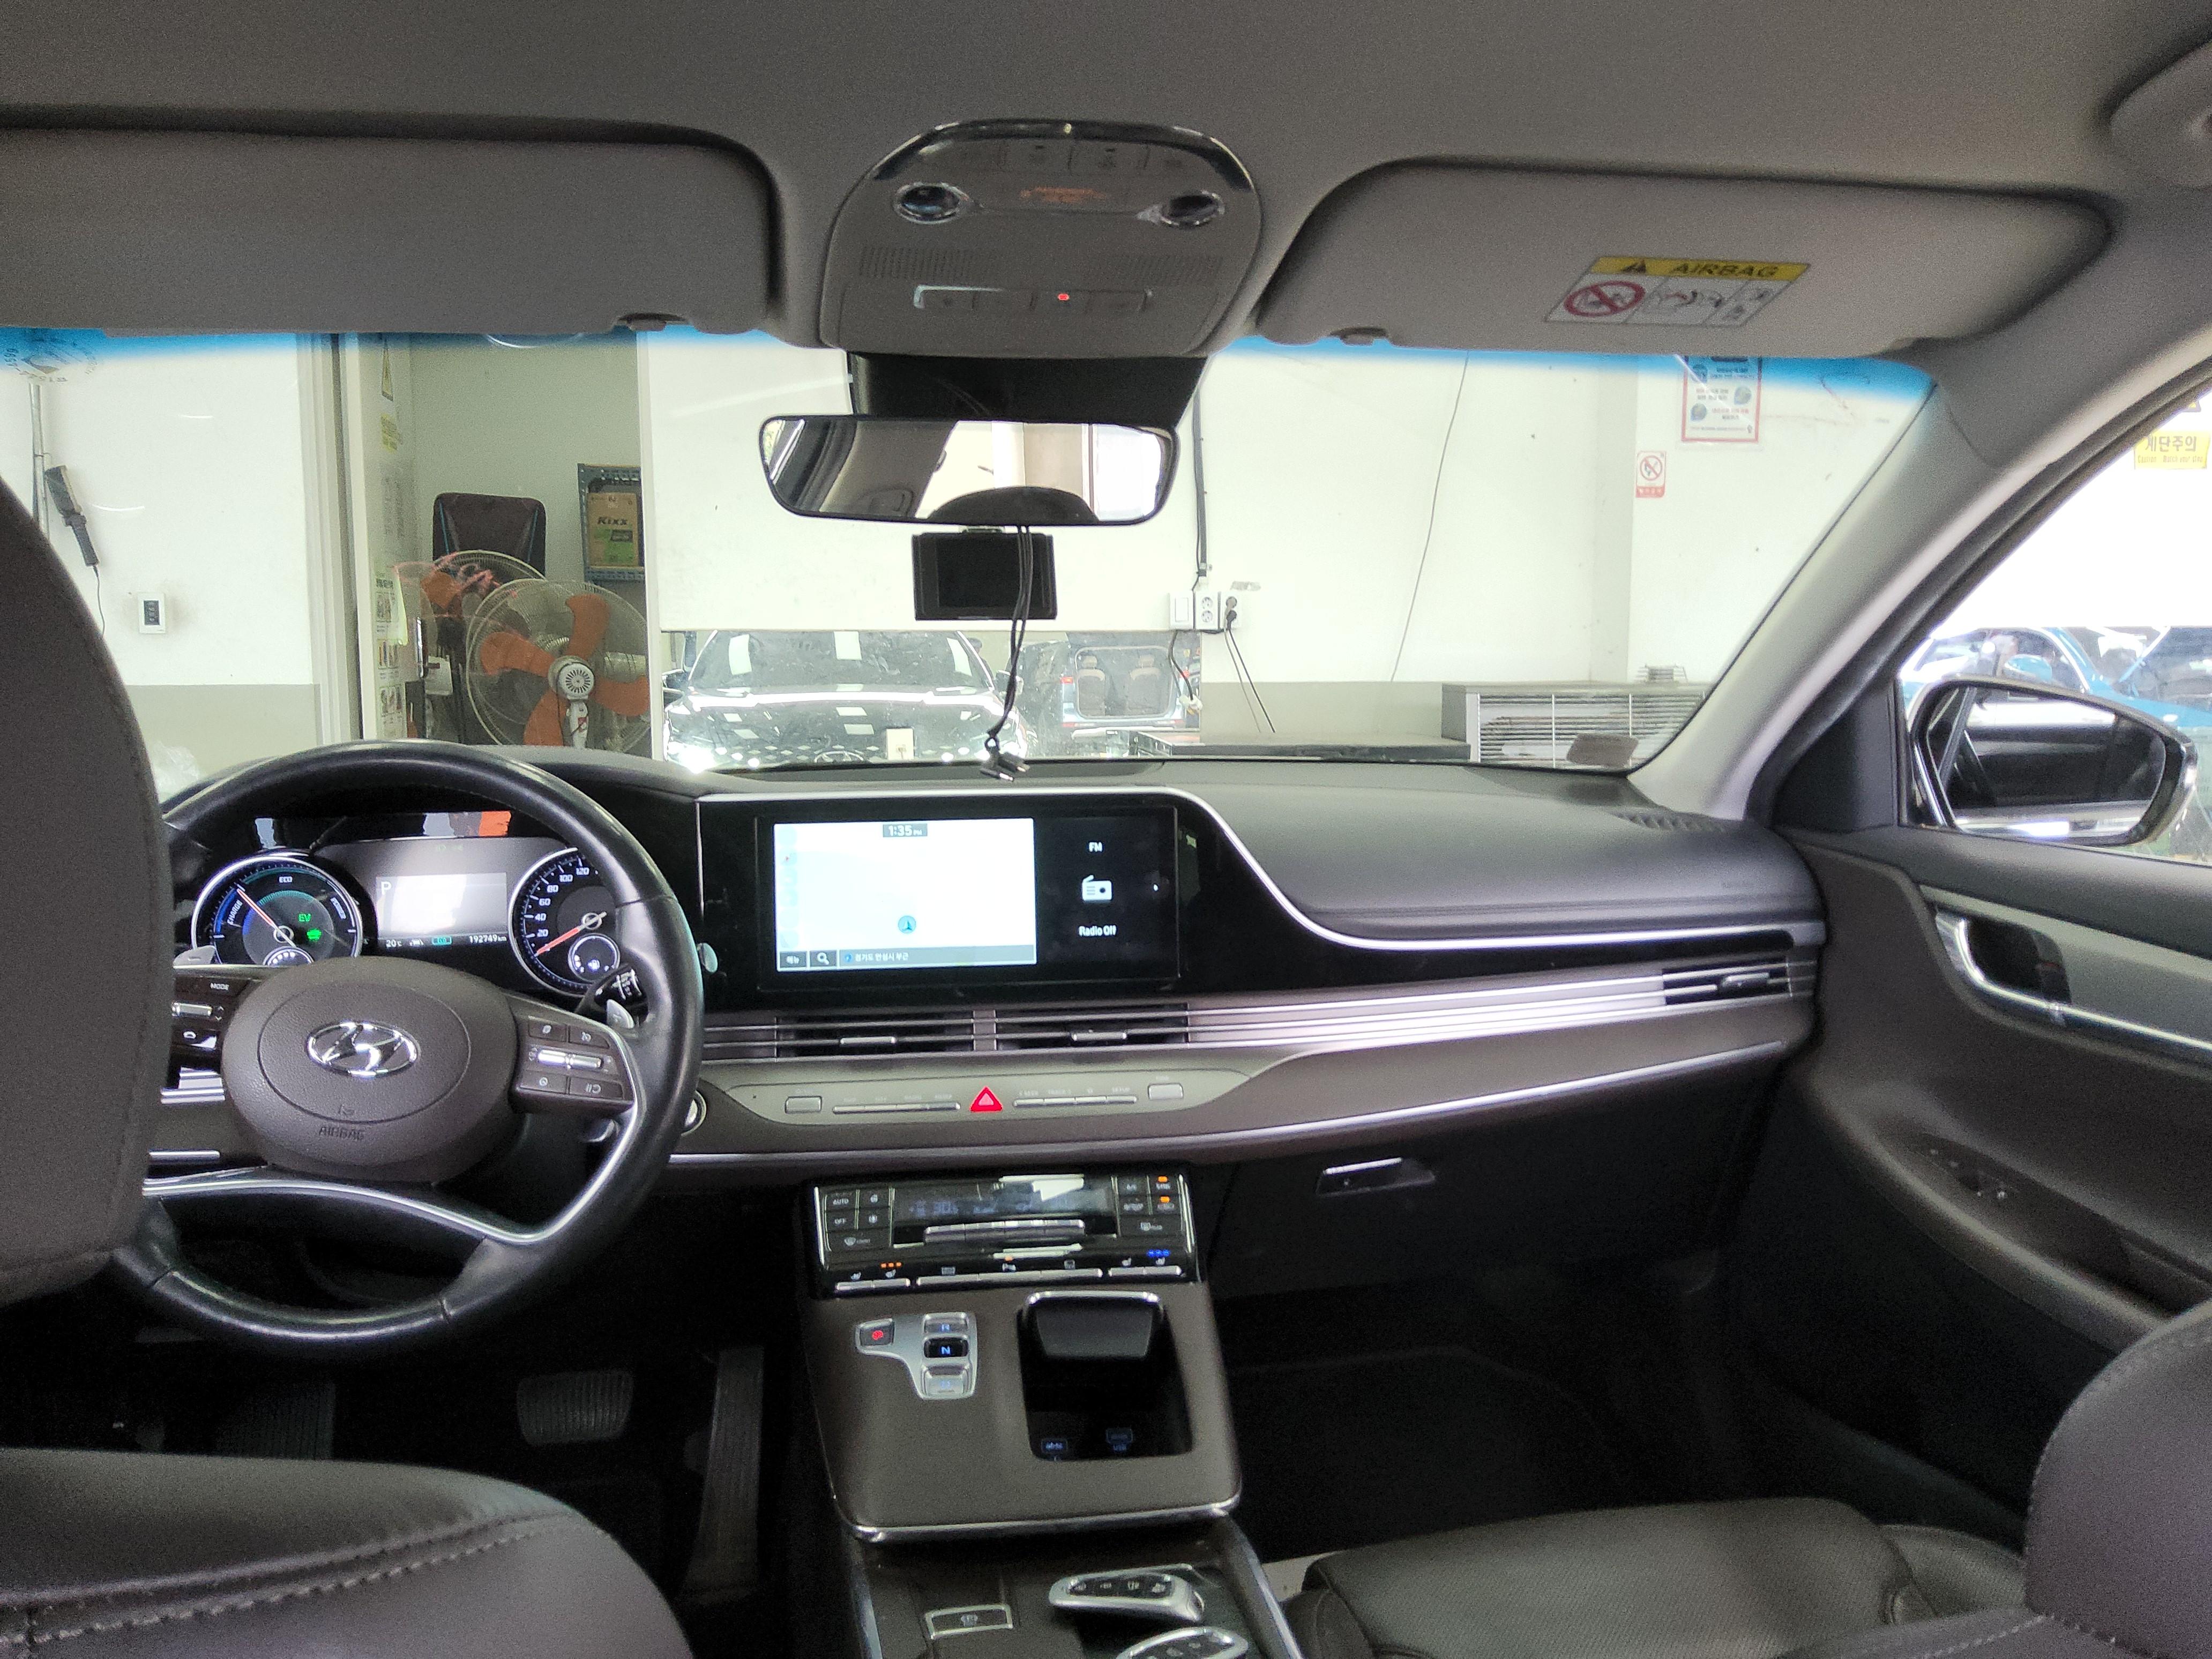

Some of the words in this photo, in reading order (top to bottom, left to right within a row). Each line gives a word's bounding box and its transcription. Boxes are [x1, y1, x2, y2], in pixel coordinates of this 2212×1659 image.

[597, 516, 628, 526] Kixx
[888, 825, 913, 836] 1:35
[1089, 841, 1103, 852] FM
[576, 867, 590, 876] 120
[559, 874, 574, 883] 100
[380, 881, 392, 895] P
[539, 898, 551, 906] 60
[226, 899, 243, 926] CHARGE
[535, 913, 547, 921] 40
[298, 913, 312, 923] EV
[537, 929, 549, 937] 20
[1079, 925, 1103, 937] Radio
[1103, 924, 1117, 936] Off
[940, 1346, 951, 1355] N
